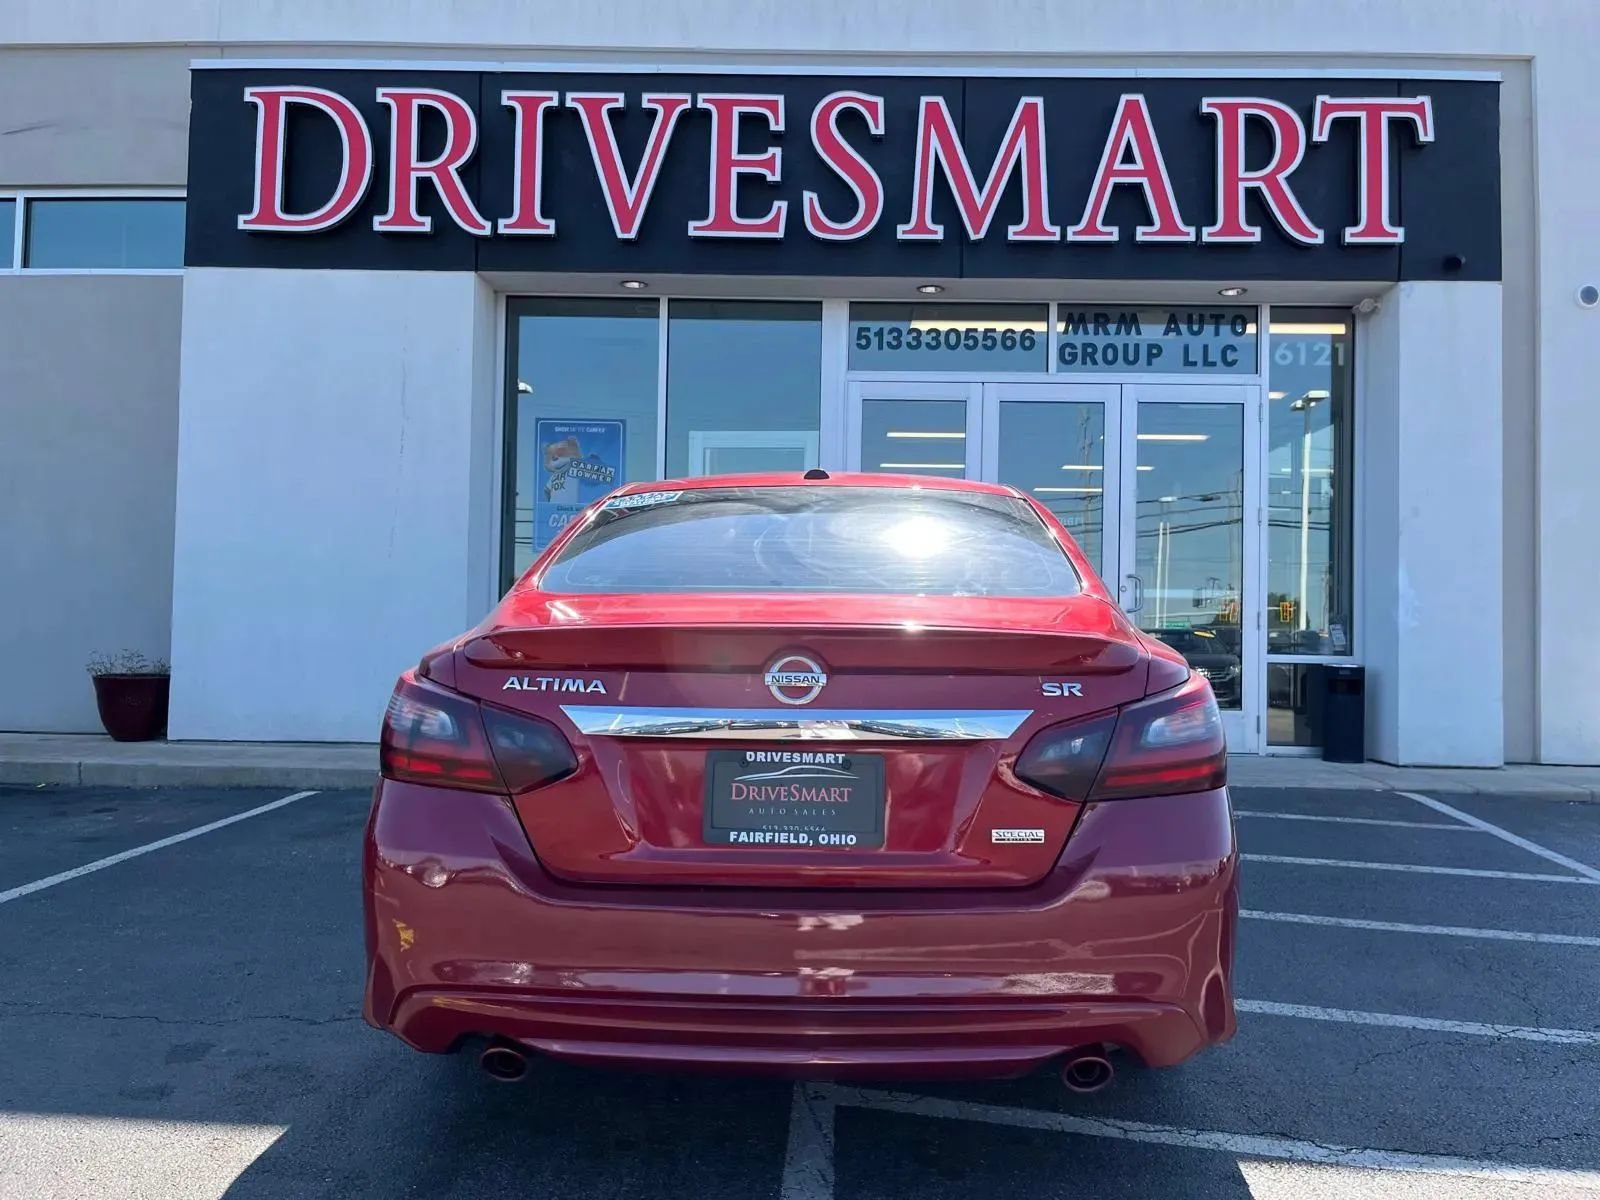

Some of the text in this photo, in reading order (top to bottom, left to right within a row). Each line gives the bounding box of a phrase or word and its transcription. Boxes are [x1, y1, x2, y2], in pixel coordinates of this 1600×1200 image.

[237, 84, 1435, 245] DRIVESMART
[1063, 311, 1248, 338] MRM AUTO
[855, 326, 1036, 352] 5133305566
[1058, 342, 1239, 368] GROUP LLC
[1274, 341, 1345, 367] 6121
[502, 675, 607, 694] ALTIMA
[771, 673, 820, 684] NISSAN
[1042, 682, 1084, 697] SR
[745, 751, 846, 764] DRIVESMART
[748, 807, 837, 817] AUTO SALES
[729, 831, 857, 847] FAIRFIELD, OHIO
